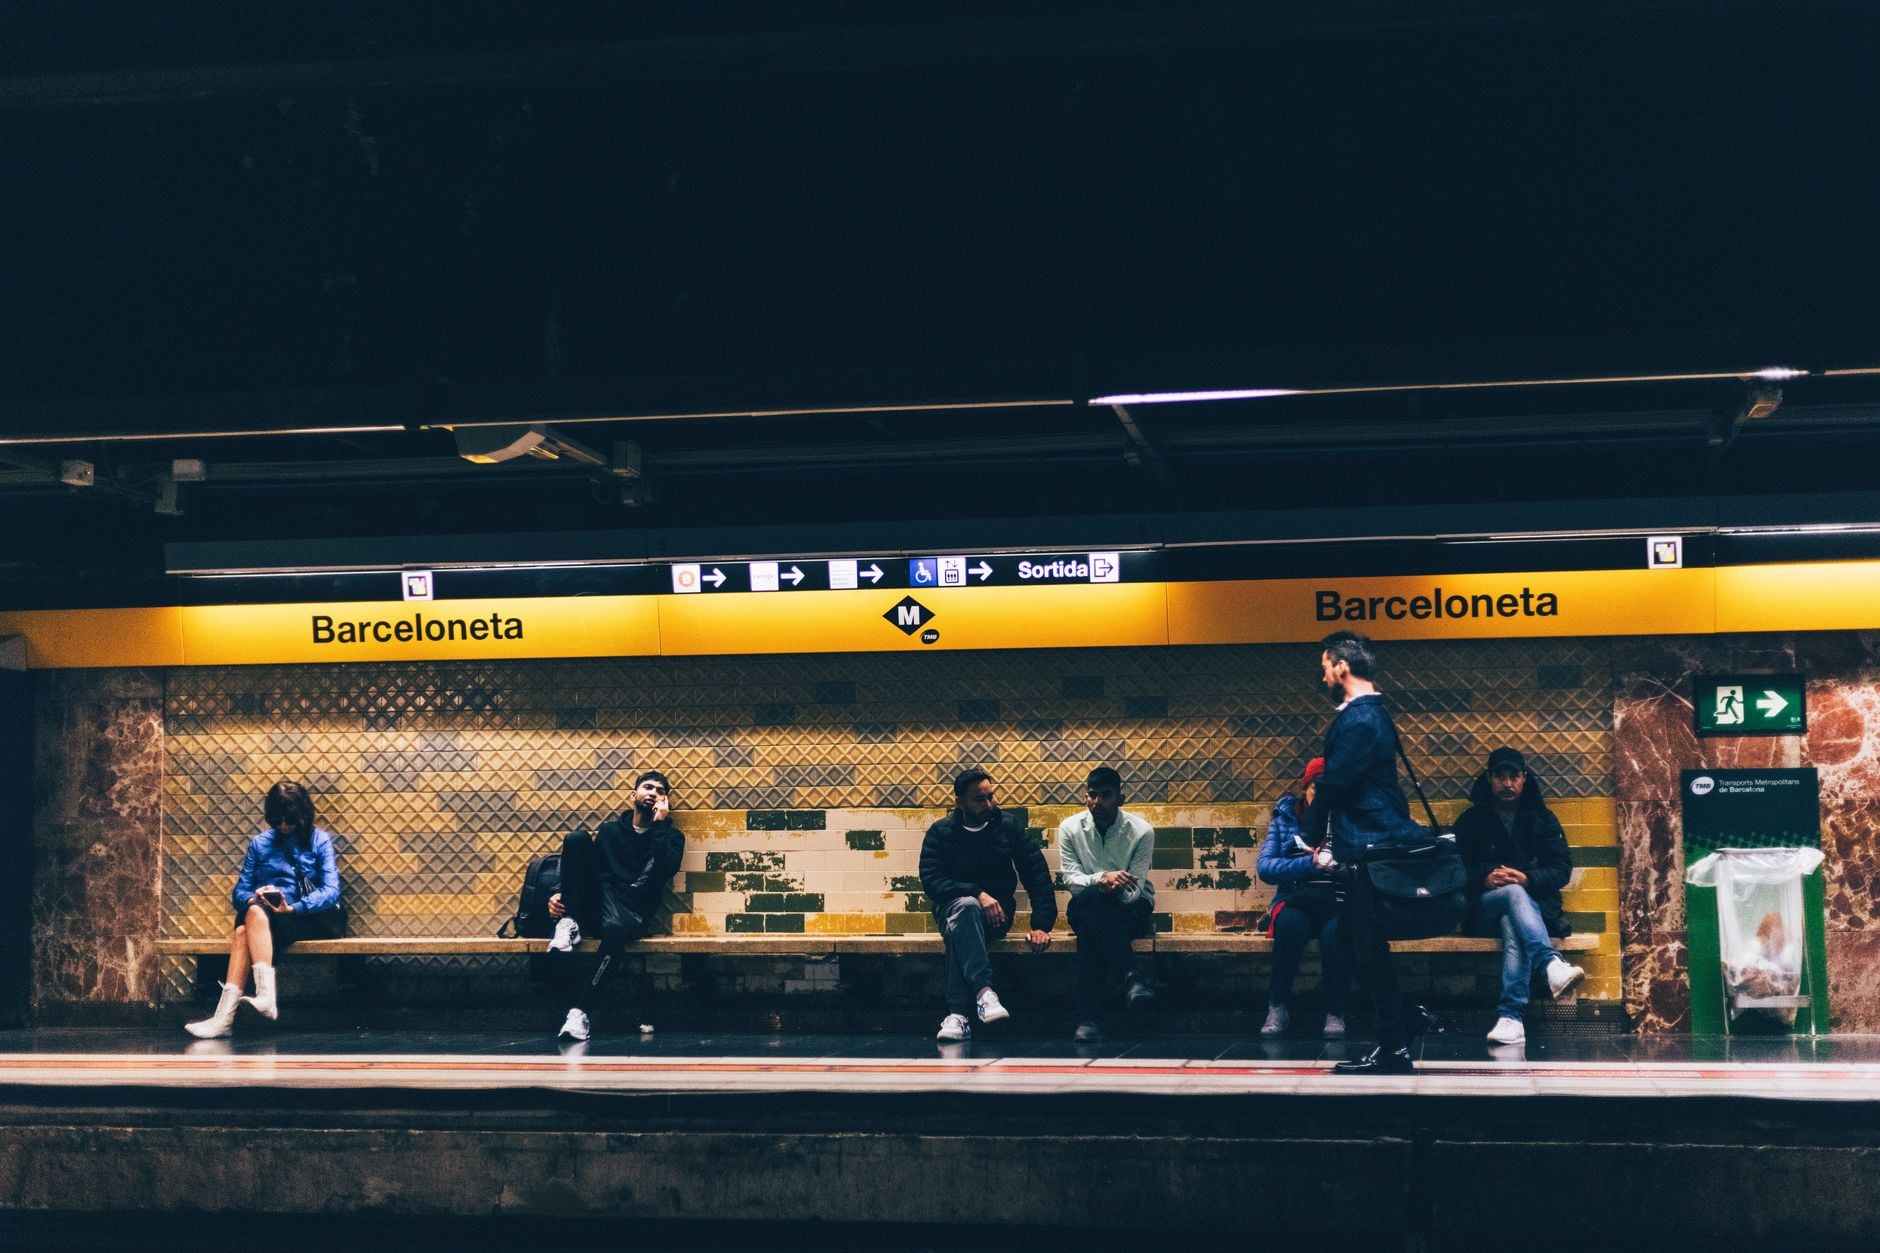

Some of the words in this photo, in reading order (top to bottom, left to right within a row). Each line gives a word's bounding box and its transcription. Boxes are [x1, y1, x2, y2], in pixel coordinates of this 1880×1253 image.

[1018, 560, 1088, 579] Sortida
[1315, 587, 1558, 622] Barceloneta
[898, 606, 920, 625] M
[312, 612, 524, 644] Barceloneta
[1719, 779, 1753, 787] Transports
